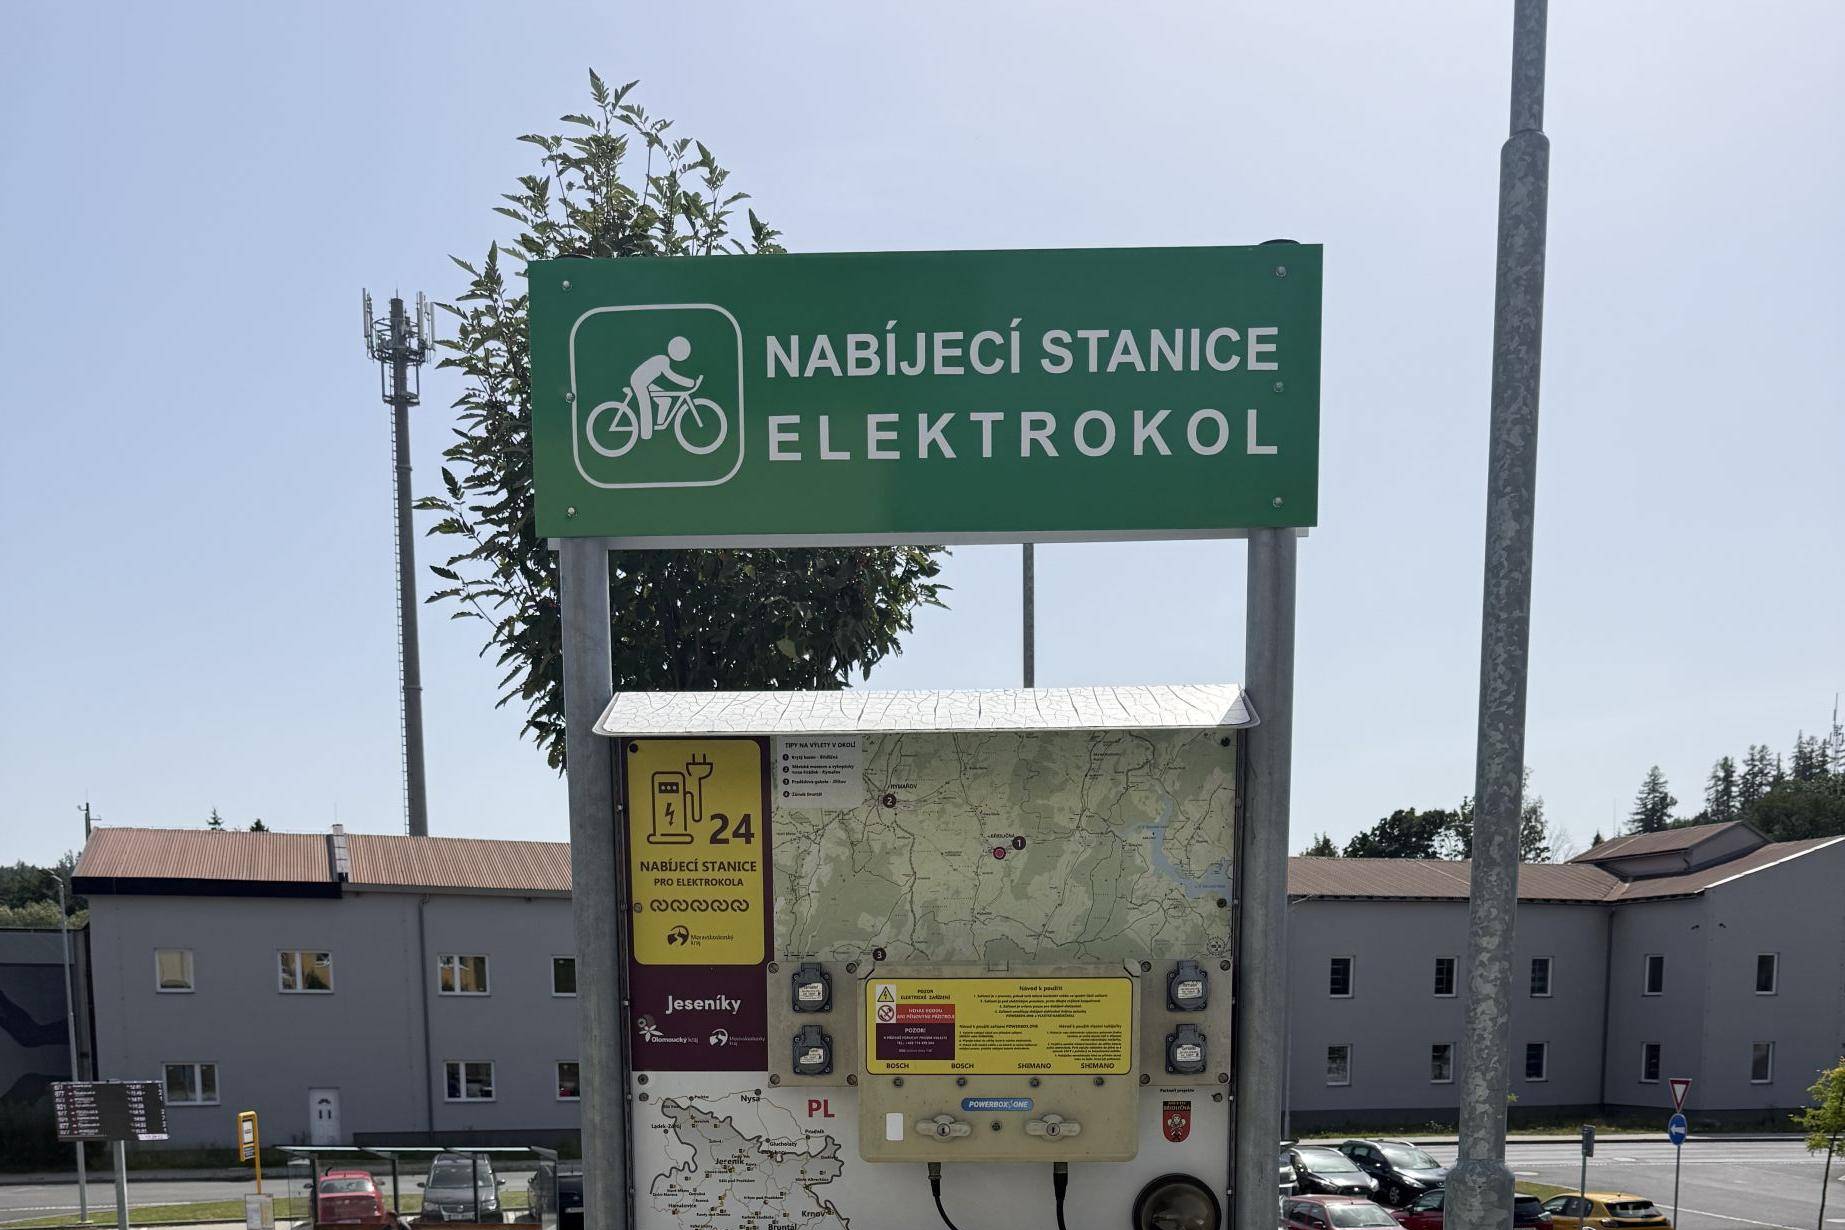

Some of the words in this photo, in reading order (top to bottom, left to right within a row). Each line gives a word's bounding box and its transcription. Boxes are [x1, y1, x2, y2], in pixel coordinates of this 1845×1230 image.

[766, 318, 1022, 378] NABÍJECÍ
[1040, 326, 1279, 374] STANICE
[768, 408, 1279, 461] ELEKTROKOL
[709, 812, 755, 845] 24
[640, 858, 699, 872] NABÍJECÍ
[702, 860, 757, 872] STANICE
[654, 878, 674, 887] PRO
[676, 878, 744, 887] ELEKTROKOLA
[665, 994, 741, 1015] Jeseníky
[740, 1095, 761, 1103] Nysa
[807, 1099, 835, 1118] PL
[801, 1210, 826, 1218] Krnov
[768, 1223, 797, 1230] Bruntál
